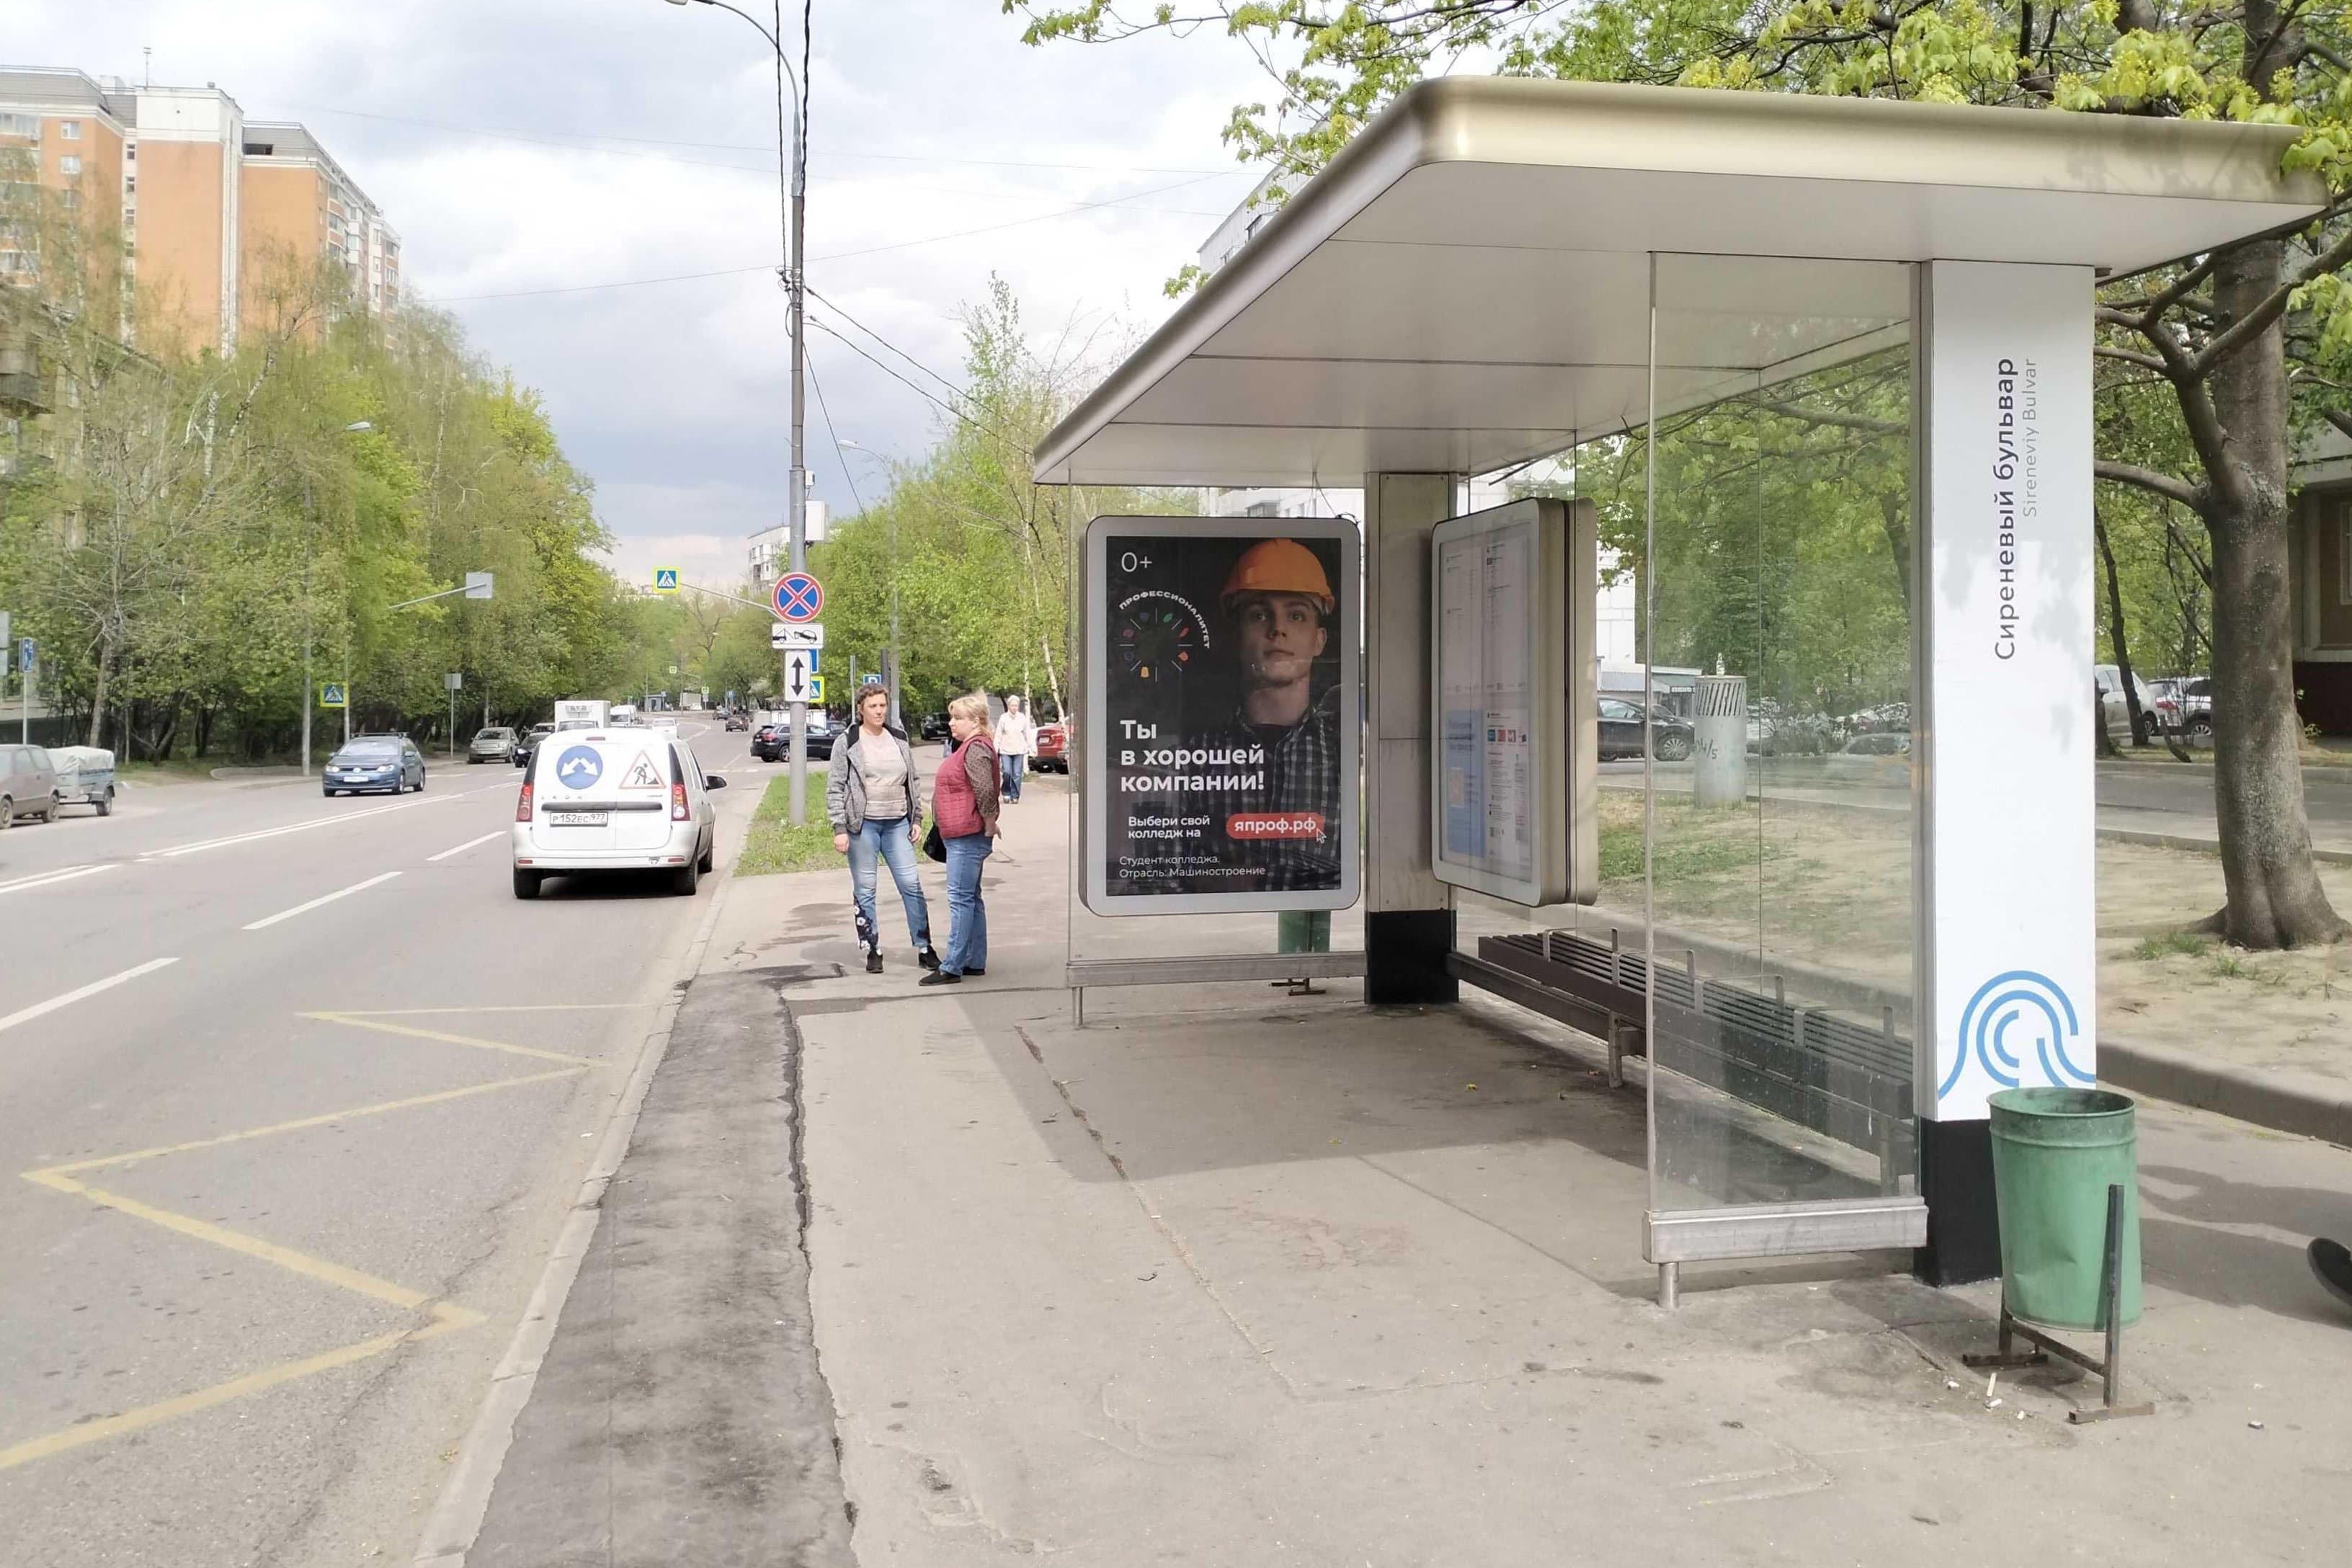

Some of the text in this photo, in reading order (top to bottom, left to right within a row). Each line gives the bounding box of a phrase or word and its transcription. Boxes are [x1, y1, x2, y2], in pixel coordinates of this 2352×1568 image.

[2022, 359, 2039, 517] Sireneviy Bulvar
[1993, 359, 2020, 659] Сиреневый бульвар
[1121, 552, 1153, 572] 0+
[1118, 590, 1211, 649] ПРОФЕССИОНАЛИТЕТ
[1120, 720, 1157, 739] Ты
[1121, 744, 1264, 770] в хорошей
[1121, 770, 1265, 791] компании!
[1128, 815, 1211, 829] Выбери свой
[1234, 817, 1317, 834] япроф.рф
[1128, 828, 1201, 839] колледж на
[1119, 855, 1221, 866] Студент колледжа.
[1119, 866, 1266, 879] Отрасль: Машиностроение
